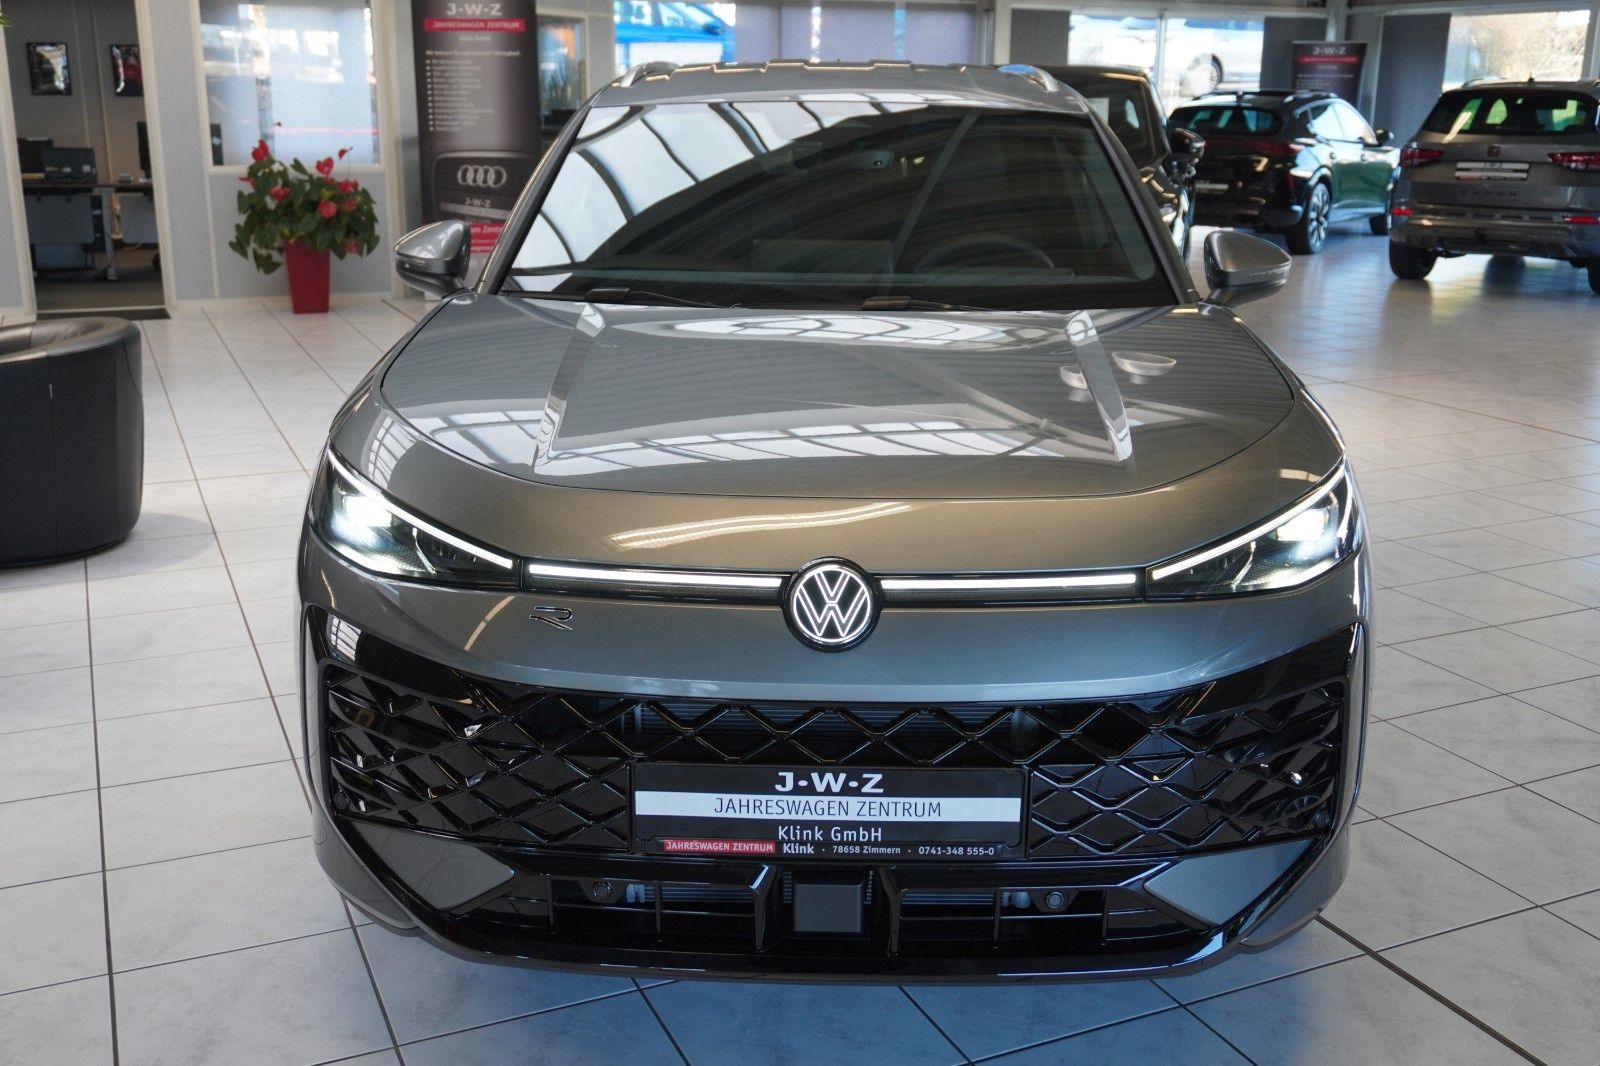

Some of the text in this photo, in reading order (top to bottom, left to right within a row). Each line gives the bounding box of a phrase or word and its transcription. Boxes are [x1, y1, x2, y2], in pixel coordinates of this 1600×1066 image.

[714, 797, 941, 818] JAHRESWAGEN ZENTRUM
[778, 825, 882, 842] Klink GmbH
[666, 840, 995, 856] JAHRESWAGEN ZENTRUM Klink 78658 Zimmern 0741-348 555-0
